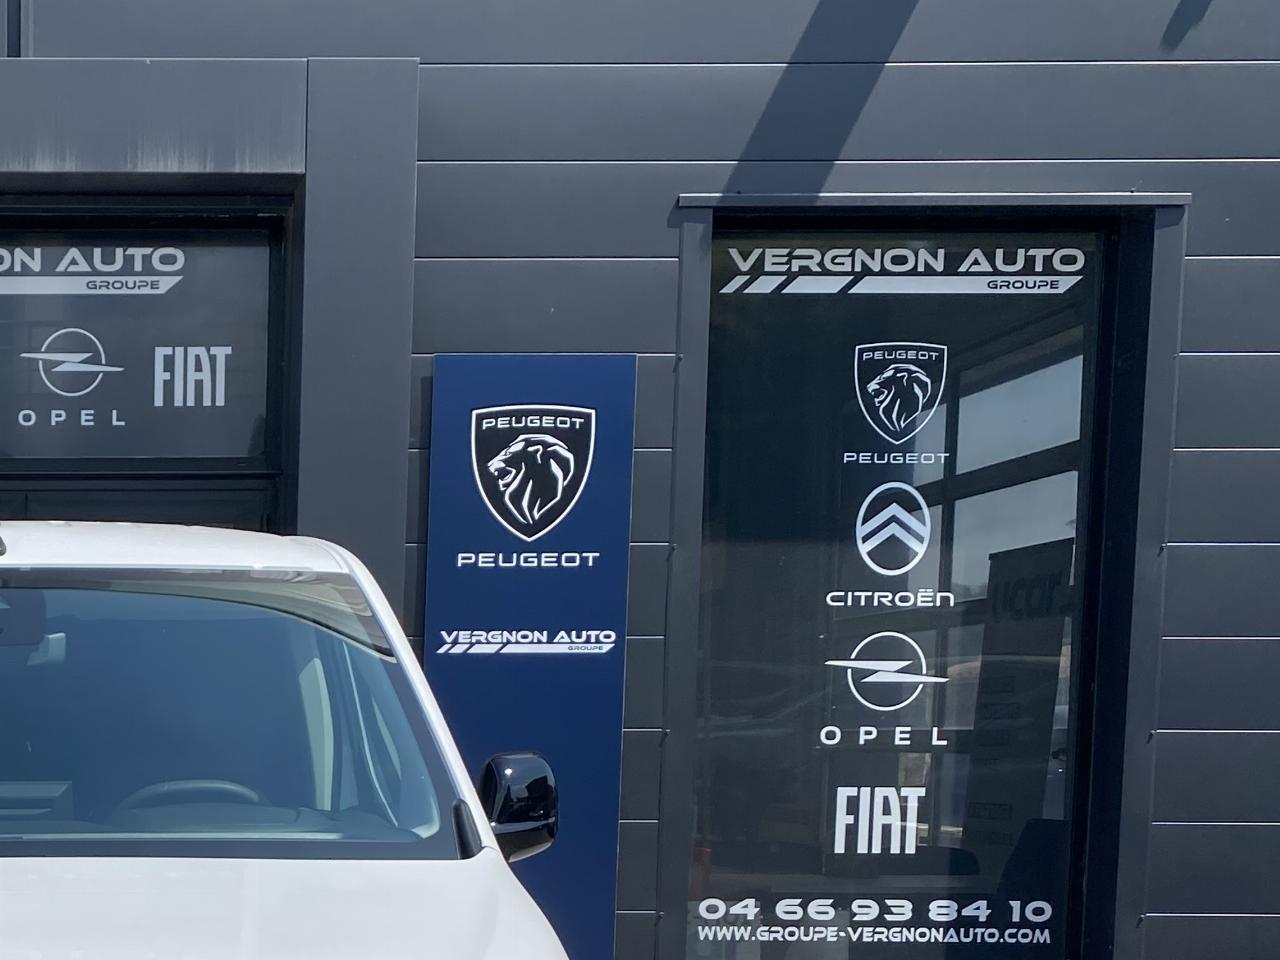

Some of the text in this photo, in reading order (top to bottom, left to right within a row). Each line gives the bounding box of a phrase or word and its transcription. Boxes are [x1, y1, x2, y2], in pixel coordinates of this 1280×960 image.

[55, 247, 185, 273] AUTO
[727, 247, 1086, 273] VERGNON AUTO
[86, 279, 161, 291] GROUPE
[987, 279, 1060, 290] GROUPE
[861, 350, 940, 361] PEUGEOT
[153, 346, 233, 407] FIAT
[17, 409, 126, 427] OPEL
[481, 415, 585, 430] PEUGEOT
[843, 452, 950, 464] PEUGEOT
[457, 552, 600, 568] PEUGEOT
[440, 630, 617, 643] VERGNON AUTO
[819, 725, 949, 746] OPEL
[833, 786, 927, 855] FIAT
[698, 898, 1052, 923] 04 66 93 84 10
[697, 925, 1052, 945] WWW.GROUPE-VERGNONAUTO.COM
